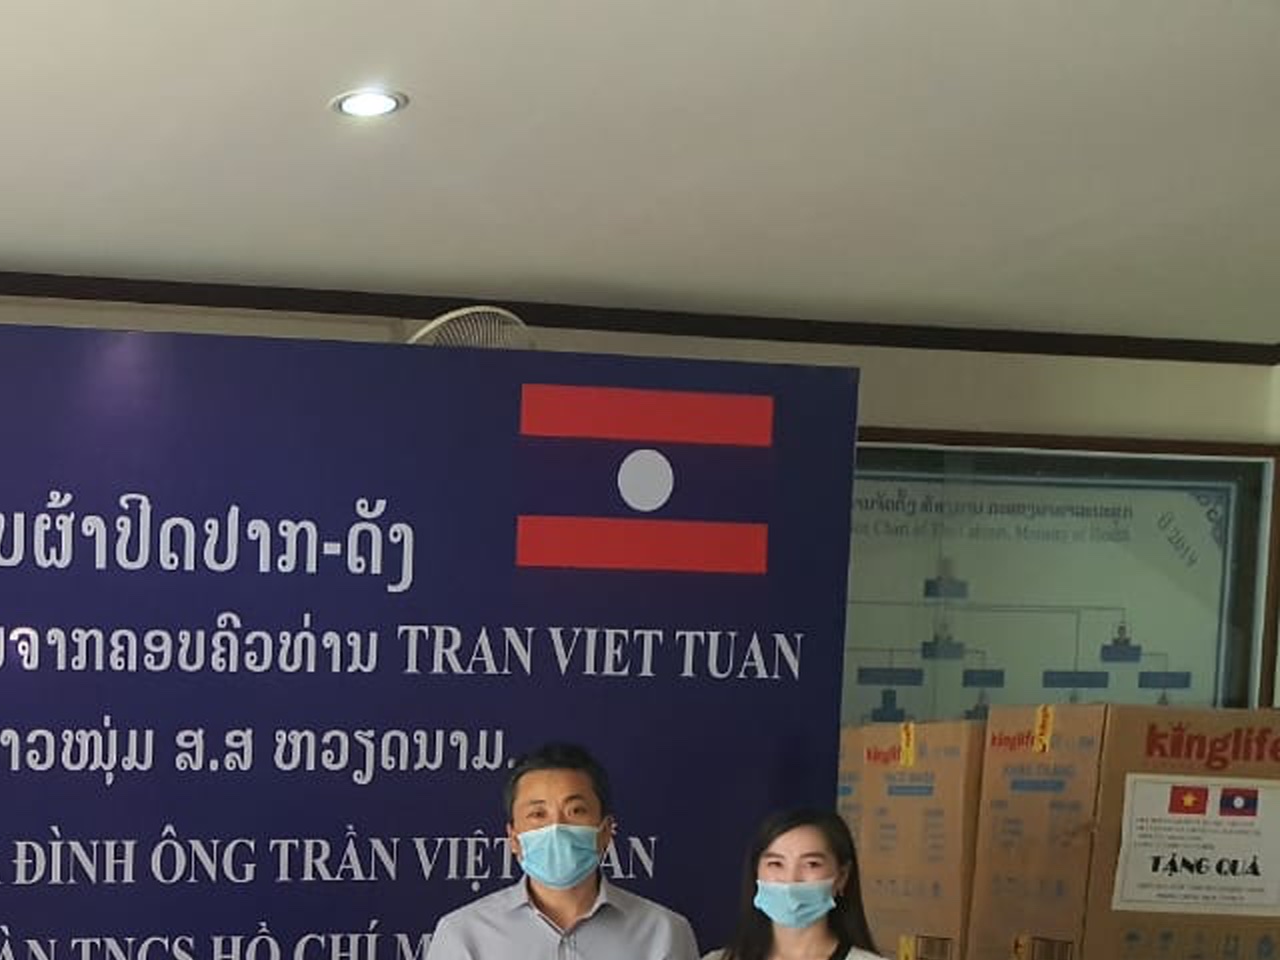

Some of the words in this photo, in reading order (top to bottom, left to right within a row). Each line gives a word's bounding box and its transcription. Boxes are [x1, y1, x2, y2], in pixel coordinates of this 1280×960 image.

[398, 625, 537, 676] TRAN
[549, 627, 664, 678] VIET
[674, 629, 806, 681] TUAN
[12, 825, 136, 885] ĐÌNH
[150, 824, 257, 885] ÔNG
[269, 823, 400, 883] TRẦN
[412, 828, 513, 892] VIỆT
